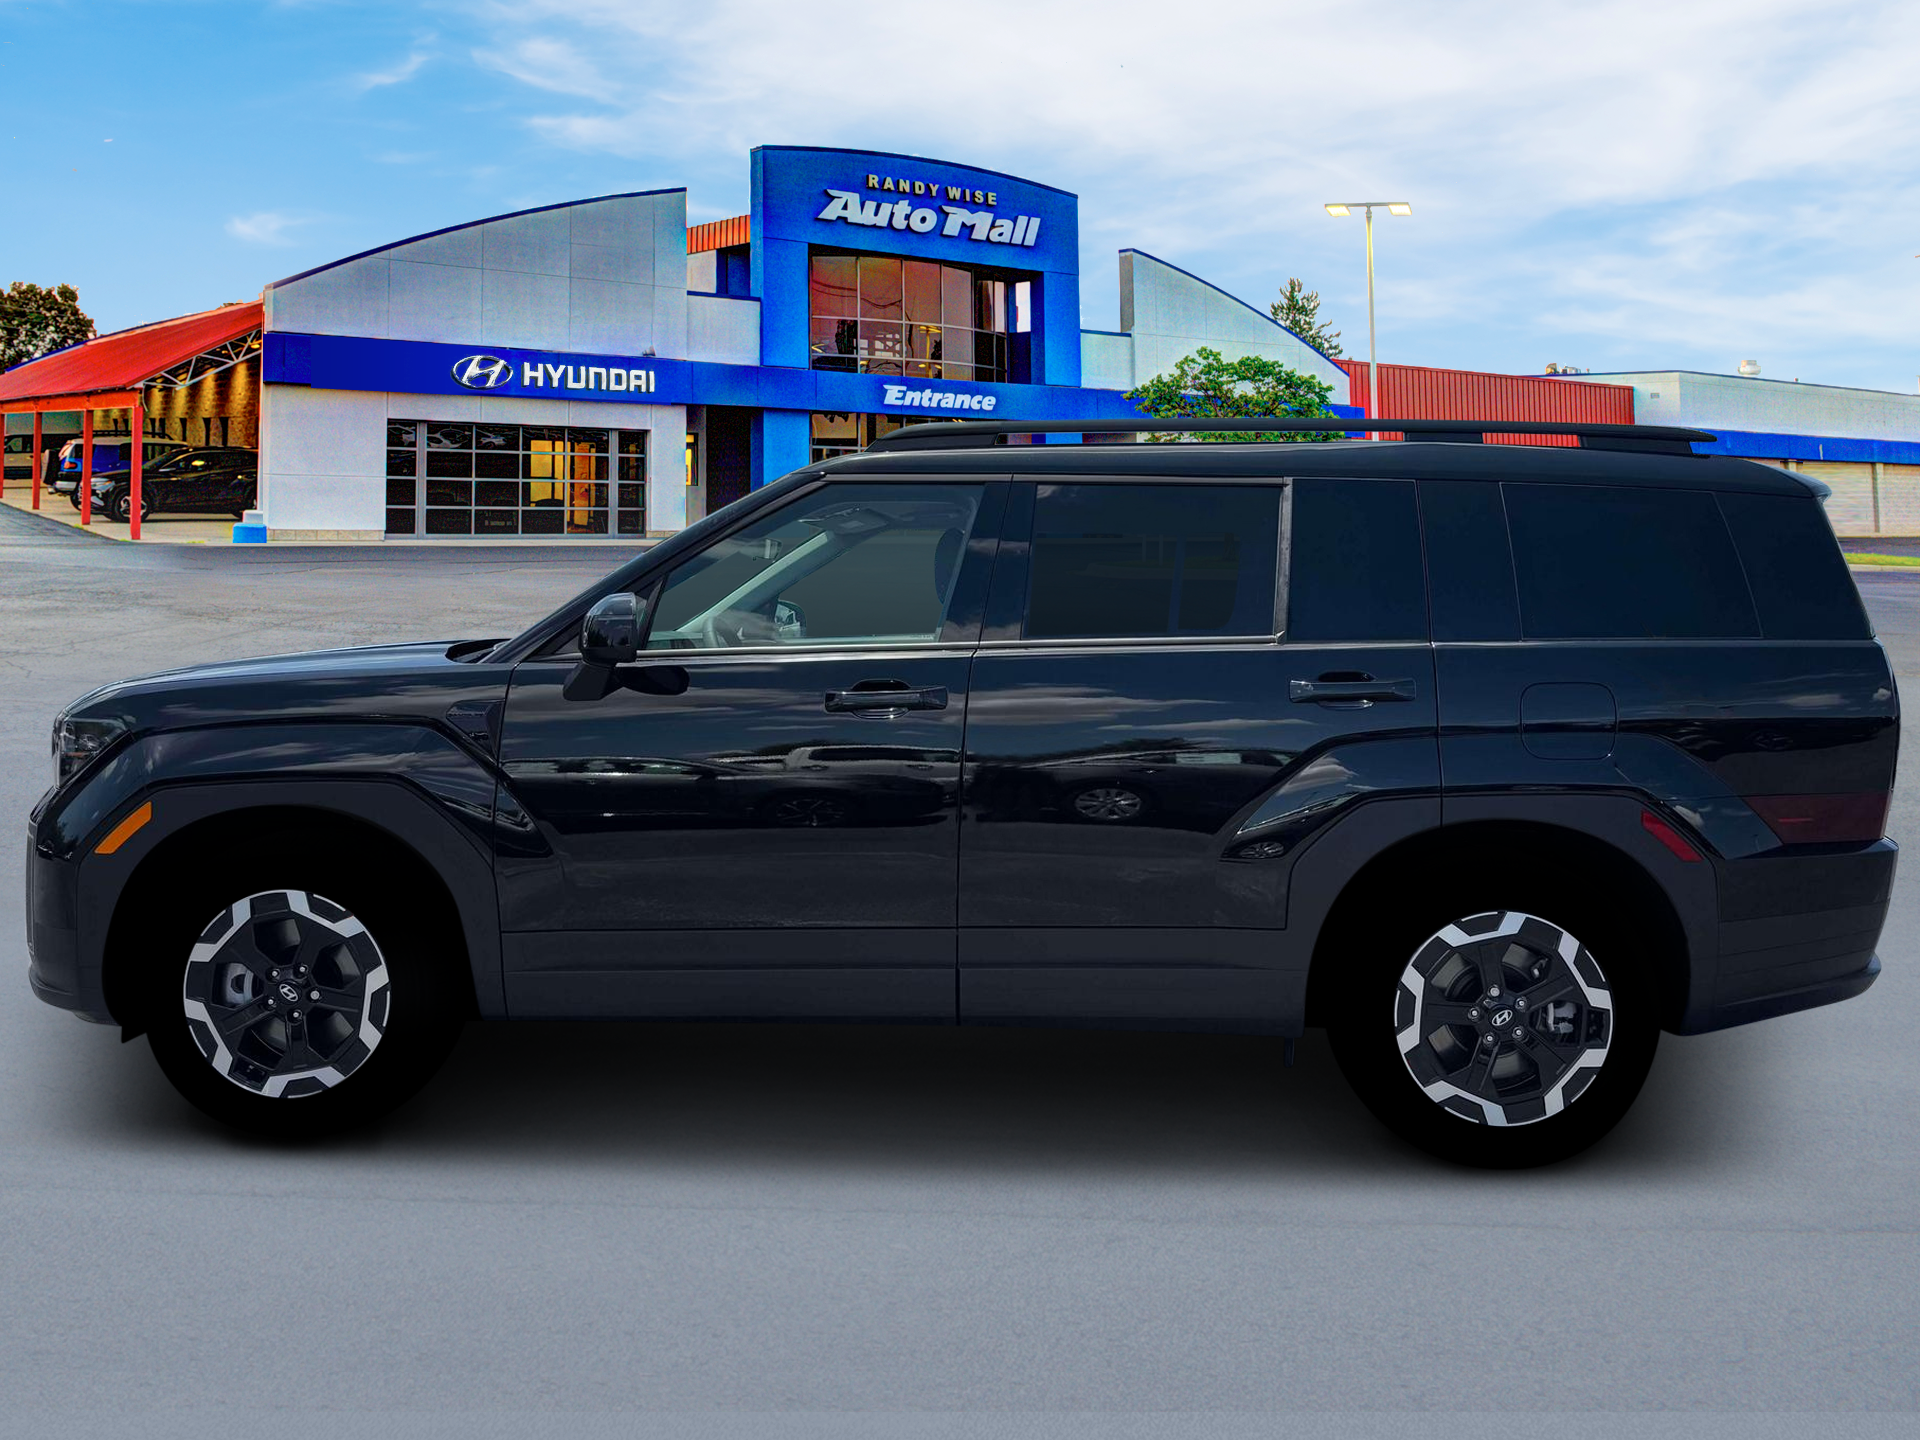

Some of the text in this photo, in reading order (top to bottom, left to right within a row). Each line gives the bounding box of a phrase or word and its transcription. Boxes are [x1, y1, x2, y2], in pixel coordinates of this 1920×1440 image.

[867, 174, 998, 206] RANDY WISE
[815, 188, 1042, 247] Auto Mall
[521, 361, 656, 393] HYUNDAI
[882, 383, 997, 412] Entrance
